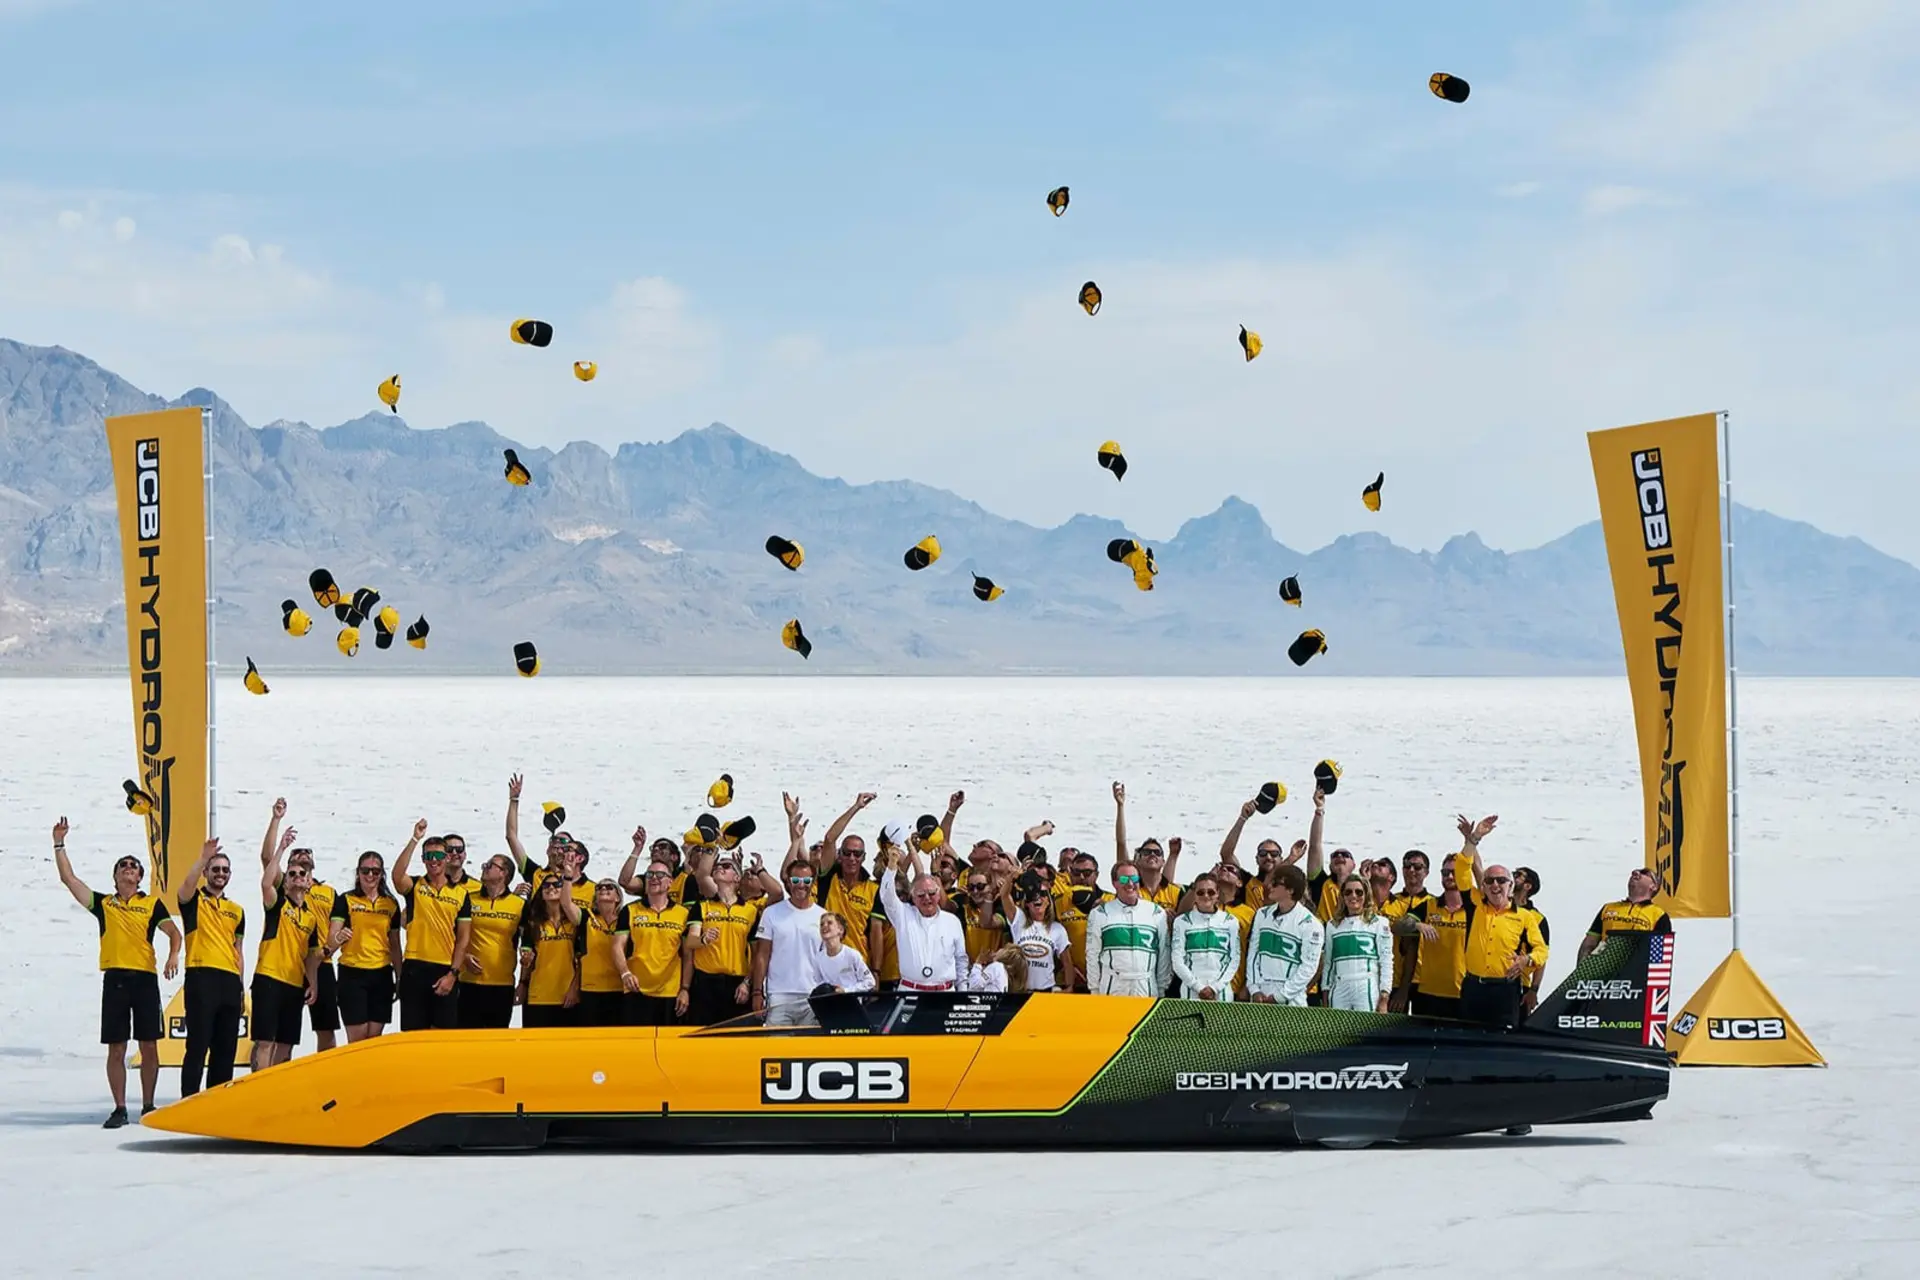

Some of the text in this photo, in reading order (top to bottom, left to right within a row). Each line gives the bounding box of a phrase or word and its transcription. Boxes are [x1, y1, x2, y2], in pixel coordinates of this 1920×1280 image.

[138, 441, 159, 539] JCB
[1634, 451, 1669, 549] JCB
[1565, 989, 1643, 999] CONTENT
[1577, 980, 1632, 990] NEVER
[1558, 1015, 1600, 1028] 522
[1673, 1013, 1699, 1035] JCB
[1710, 1019, 1784, 1039] JCB
[766, 1061, 904, 1101] JCB
[1177, 1070, 1405, 1090] JCB HYDROMAX
